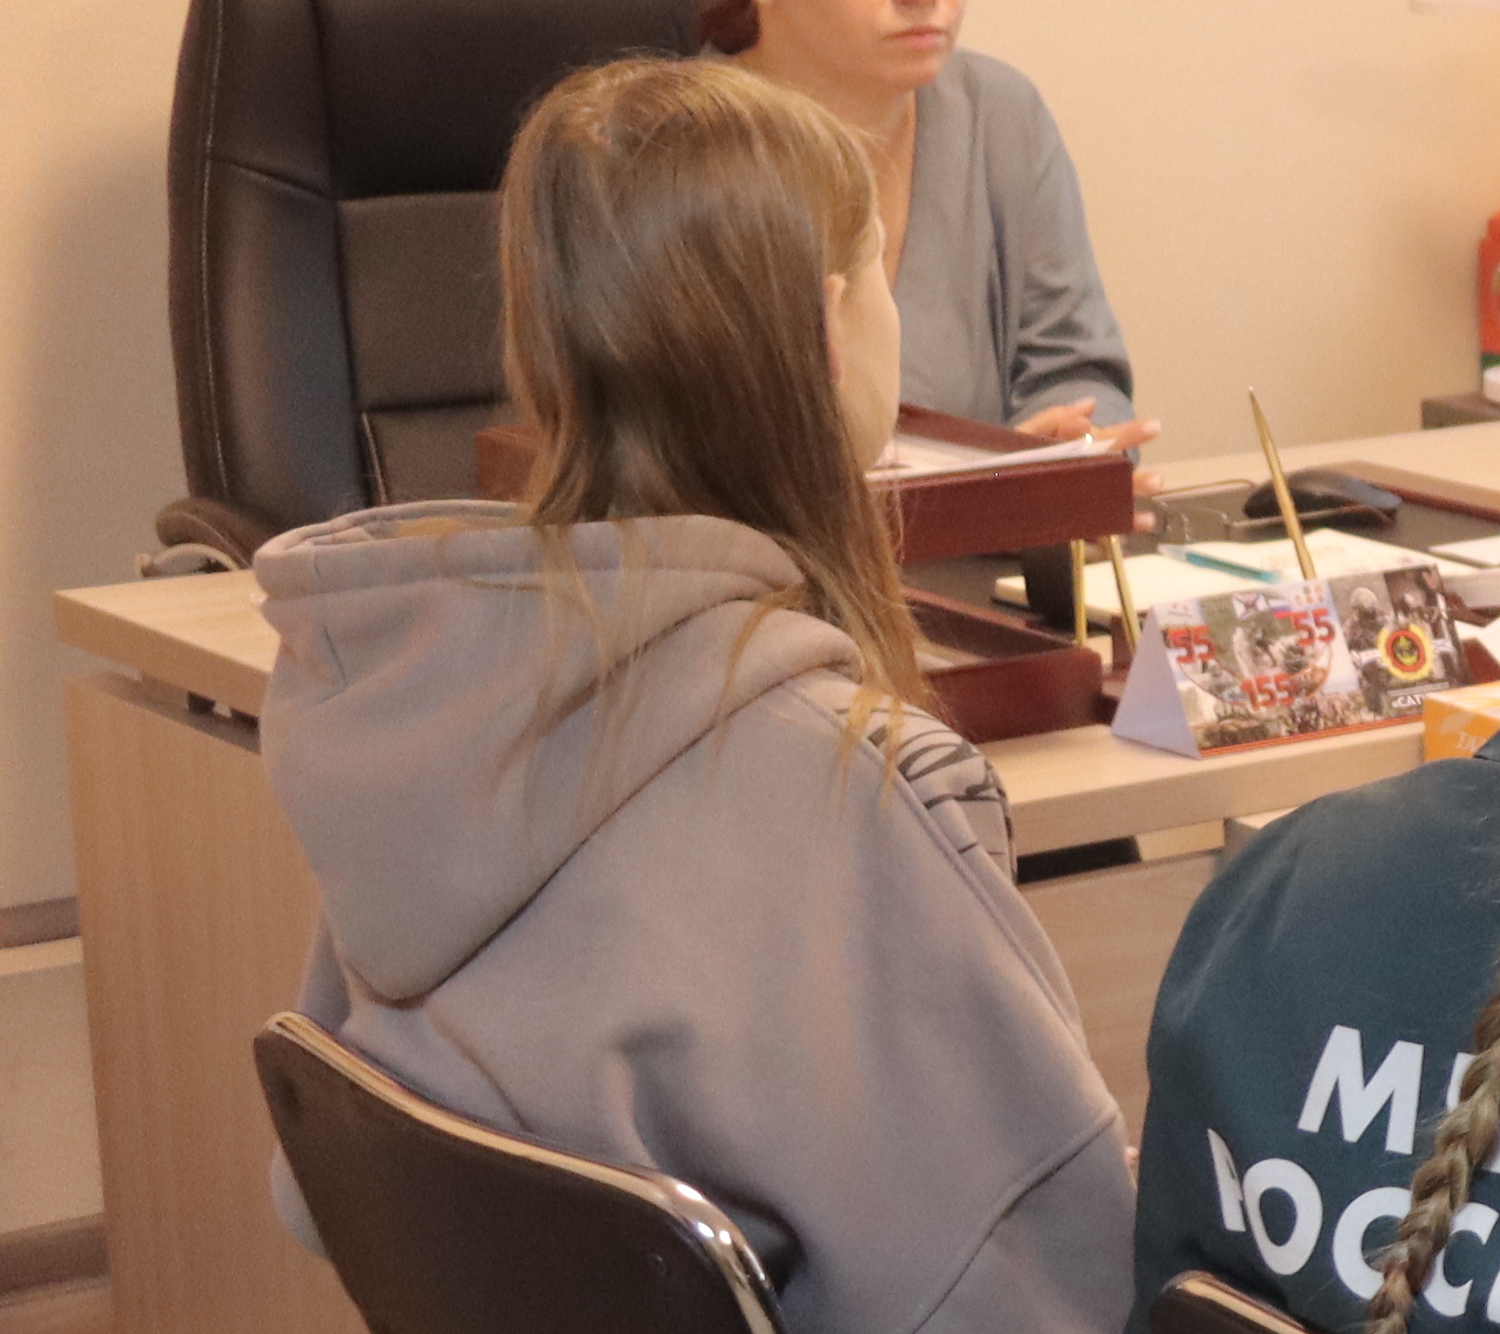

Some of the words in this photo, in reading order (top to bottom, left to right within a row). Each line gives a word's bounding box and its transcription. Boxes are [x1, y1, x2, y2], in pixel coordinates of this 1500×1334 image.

[1167, 625, 1217, 664] 55
[1290, 609, 1336, 647] 55
[1240, 672, 1296, 711] 155
